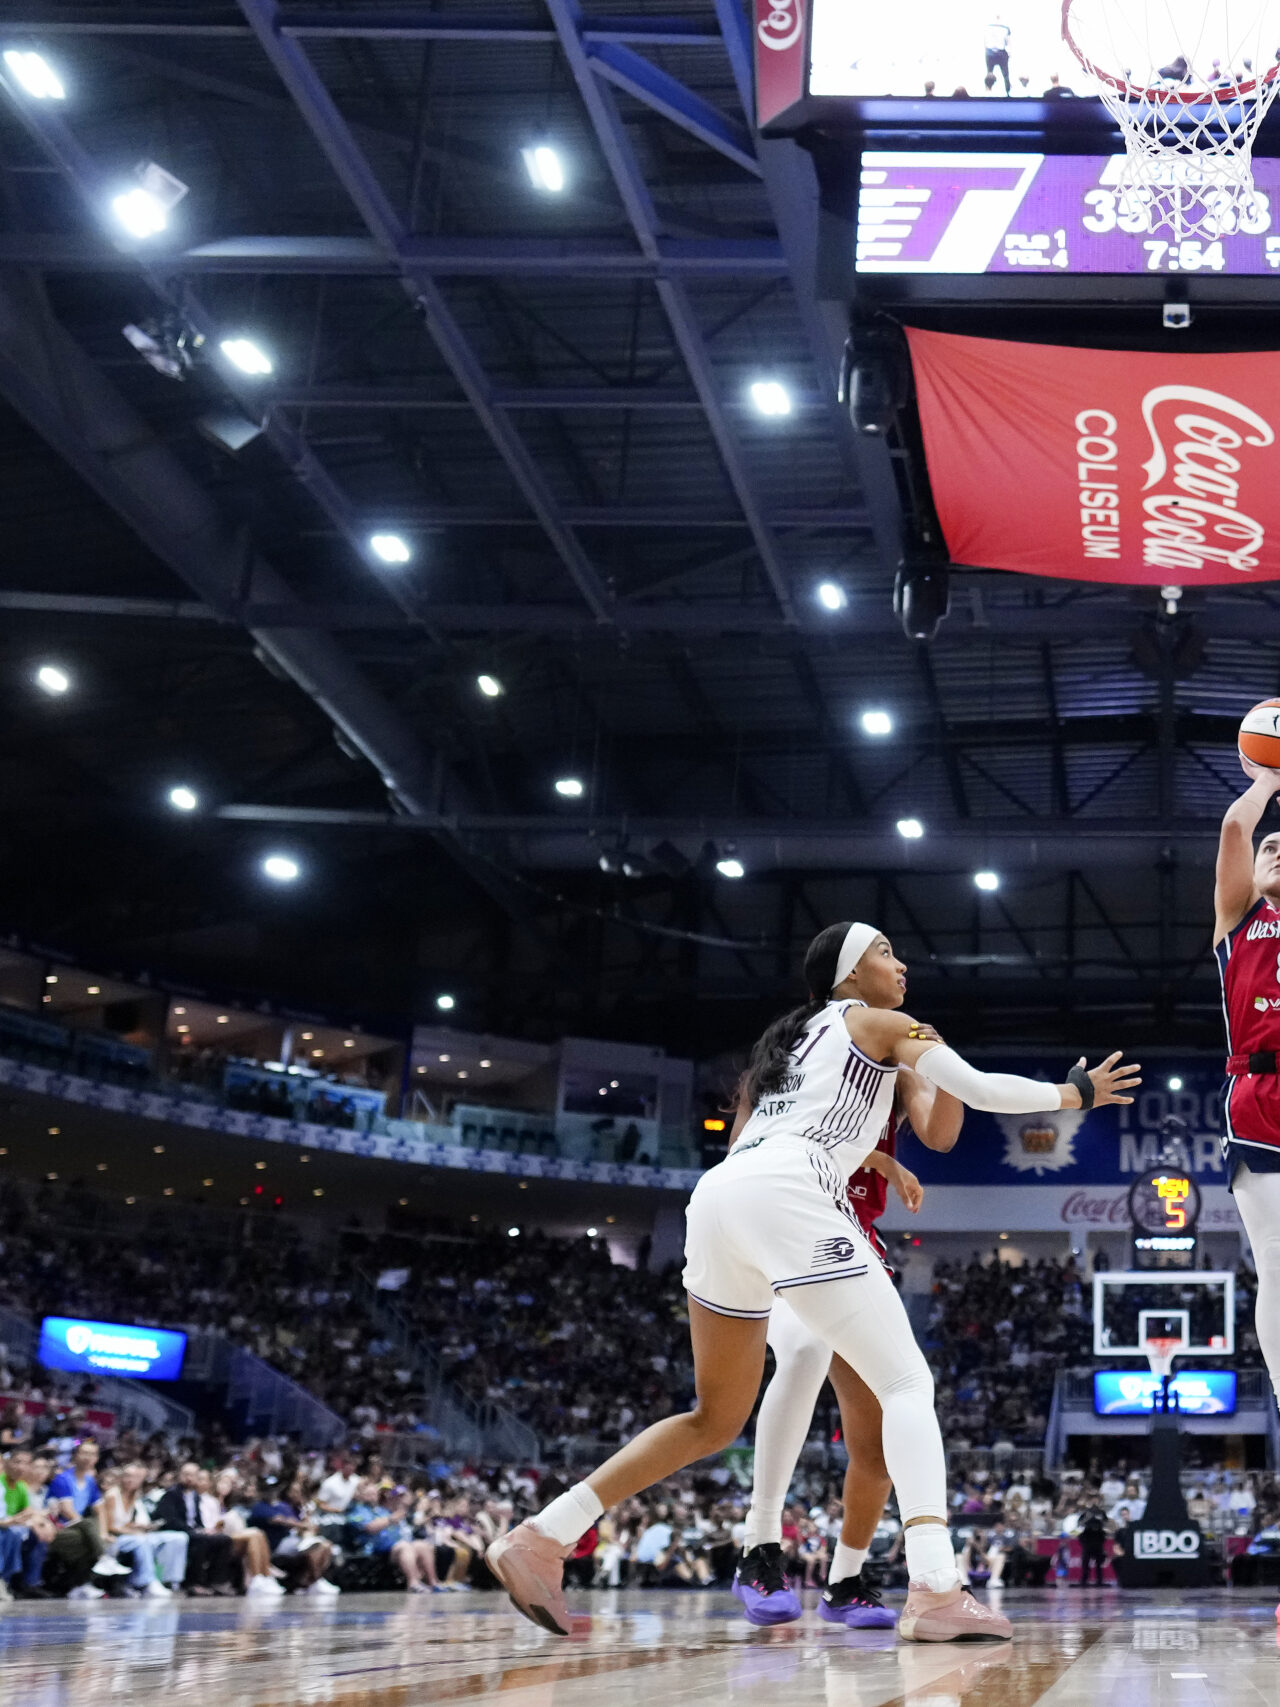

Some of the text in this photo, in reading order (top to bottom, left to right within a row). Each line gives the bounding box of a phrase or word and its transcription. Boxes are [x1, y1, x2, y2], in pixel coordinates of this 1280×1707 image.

[1143, 240, 1225, 271] 7:54
[1075, 409, 1121, 559] COLISEUM
[1141, 384, 1275, 572] Coca-Cola
[1165, 1196, 1186, 1228] 5
[1142, 1530, 1200, 1552] BDO
